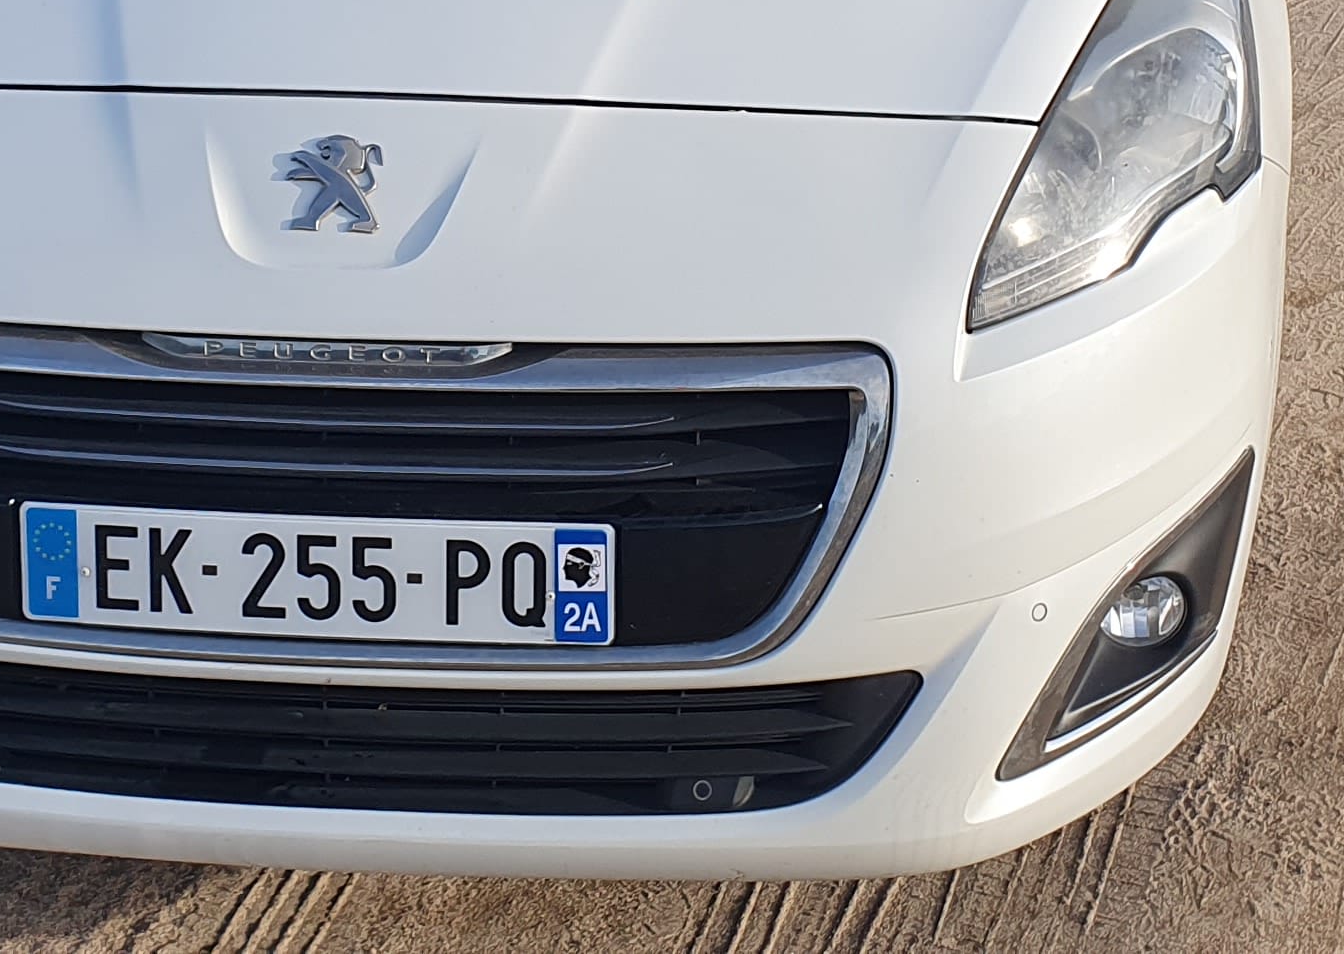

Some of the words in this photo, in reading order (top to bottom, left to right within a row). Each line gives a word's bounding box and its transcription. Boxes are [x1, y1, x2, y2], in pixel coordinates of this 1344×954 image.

[203, 340, 441, 365] PEUGEOT
[46, 576, 61, 600] F
[94, 524, 547, 628] EK-255-PQ
[563, 602, 602, 633] 2A
